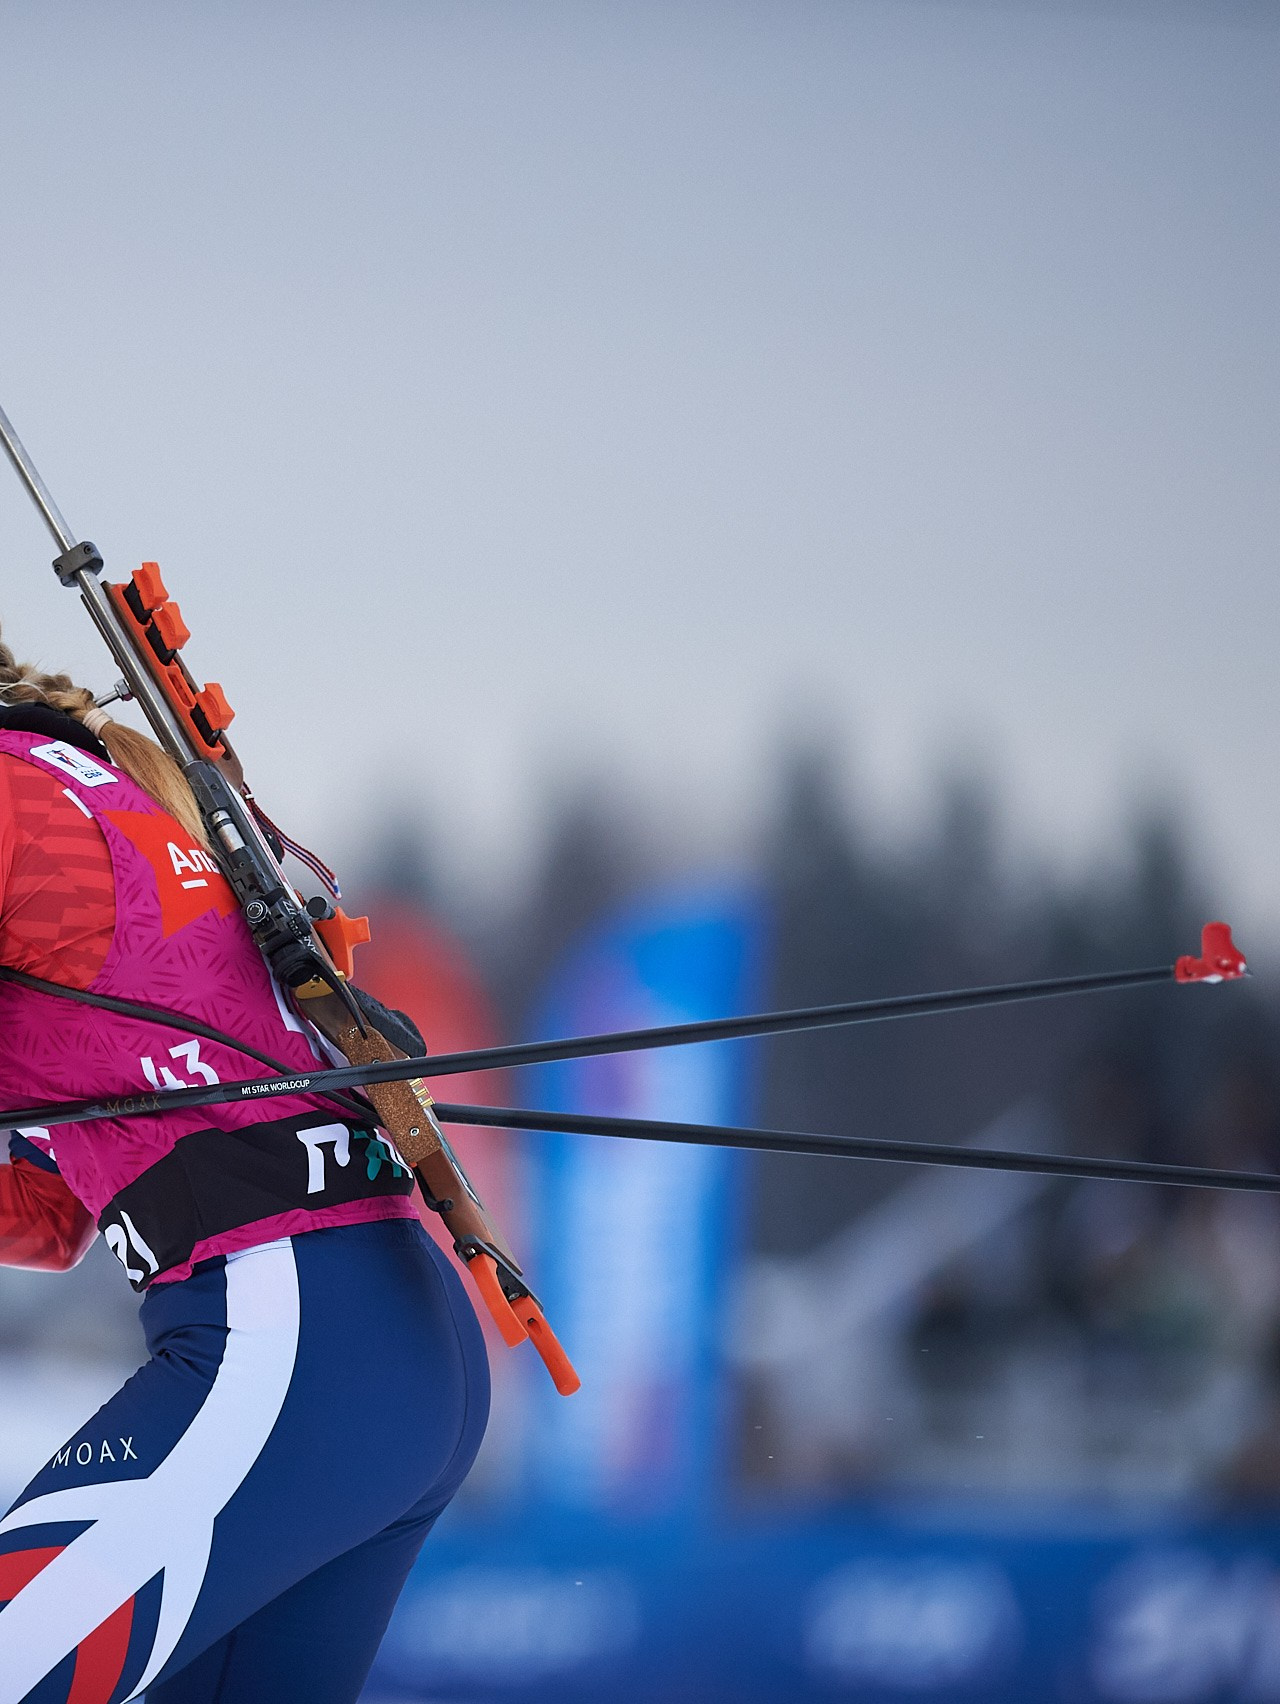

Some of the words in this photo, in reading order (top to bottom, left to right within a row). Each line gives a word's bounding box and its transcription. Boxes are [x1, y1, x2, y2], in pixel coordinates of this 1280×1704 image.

[166, 841, 221, 876] Аль
[140, 1039, 220, 1092] 43
[106, 1094, 162, 1114] MOAX
[252, 1084, 270, 1094] STAR
[51, 1436, 139, 1469] MOAX
